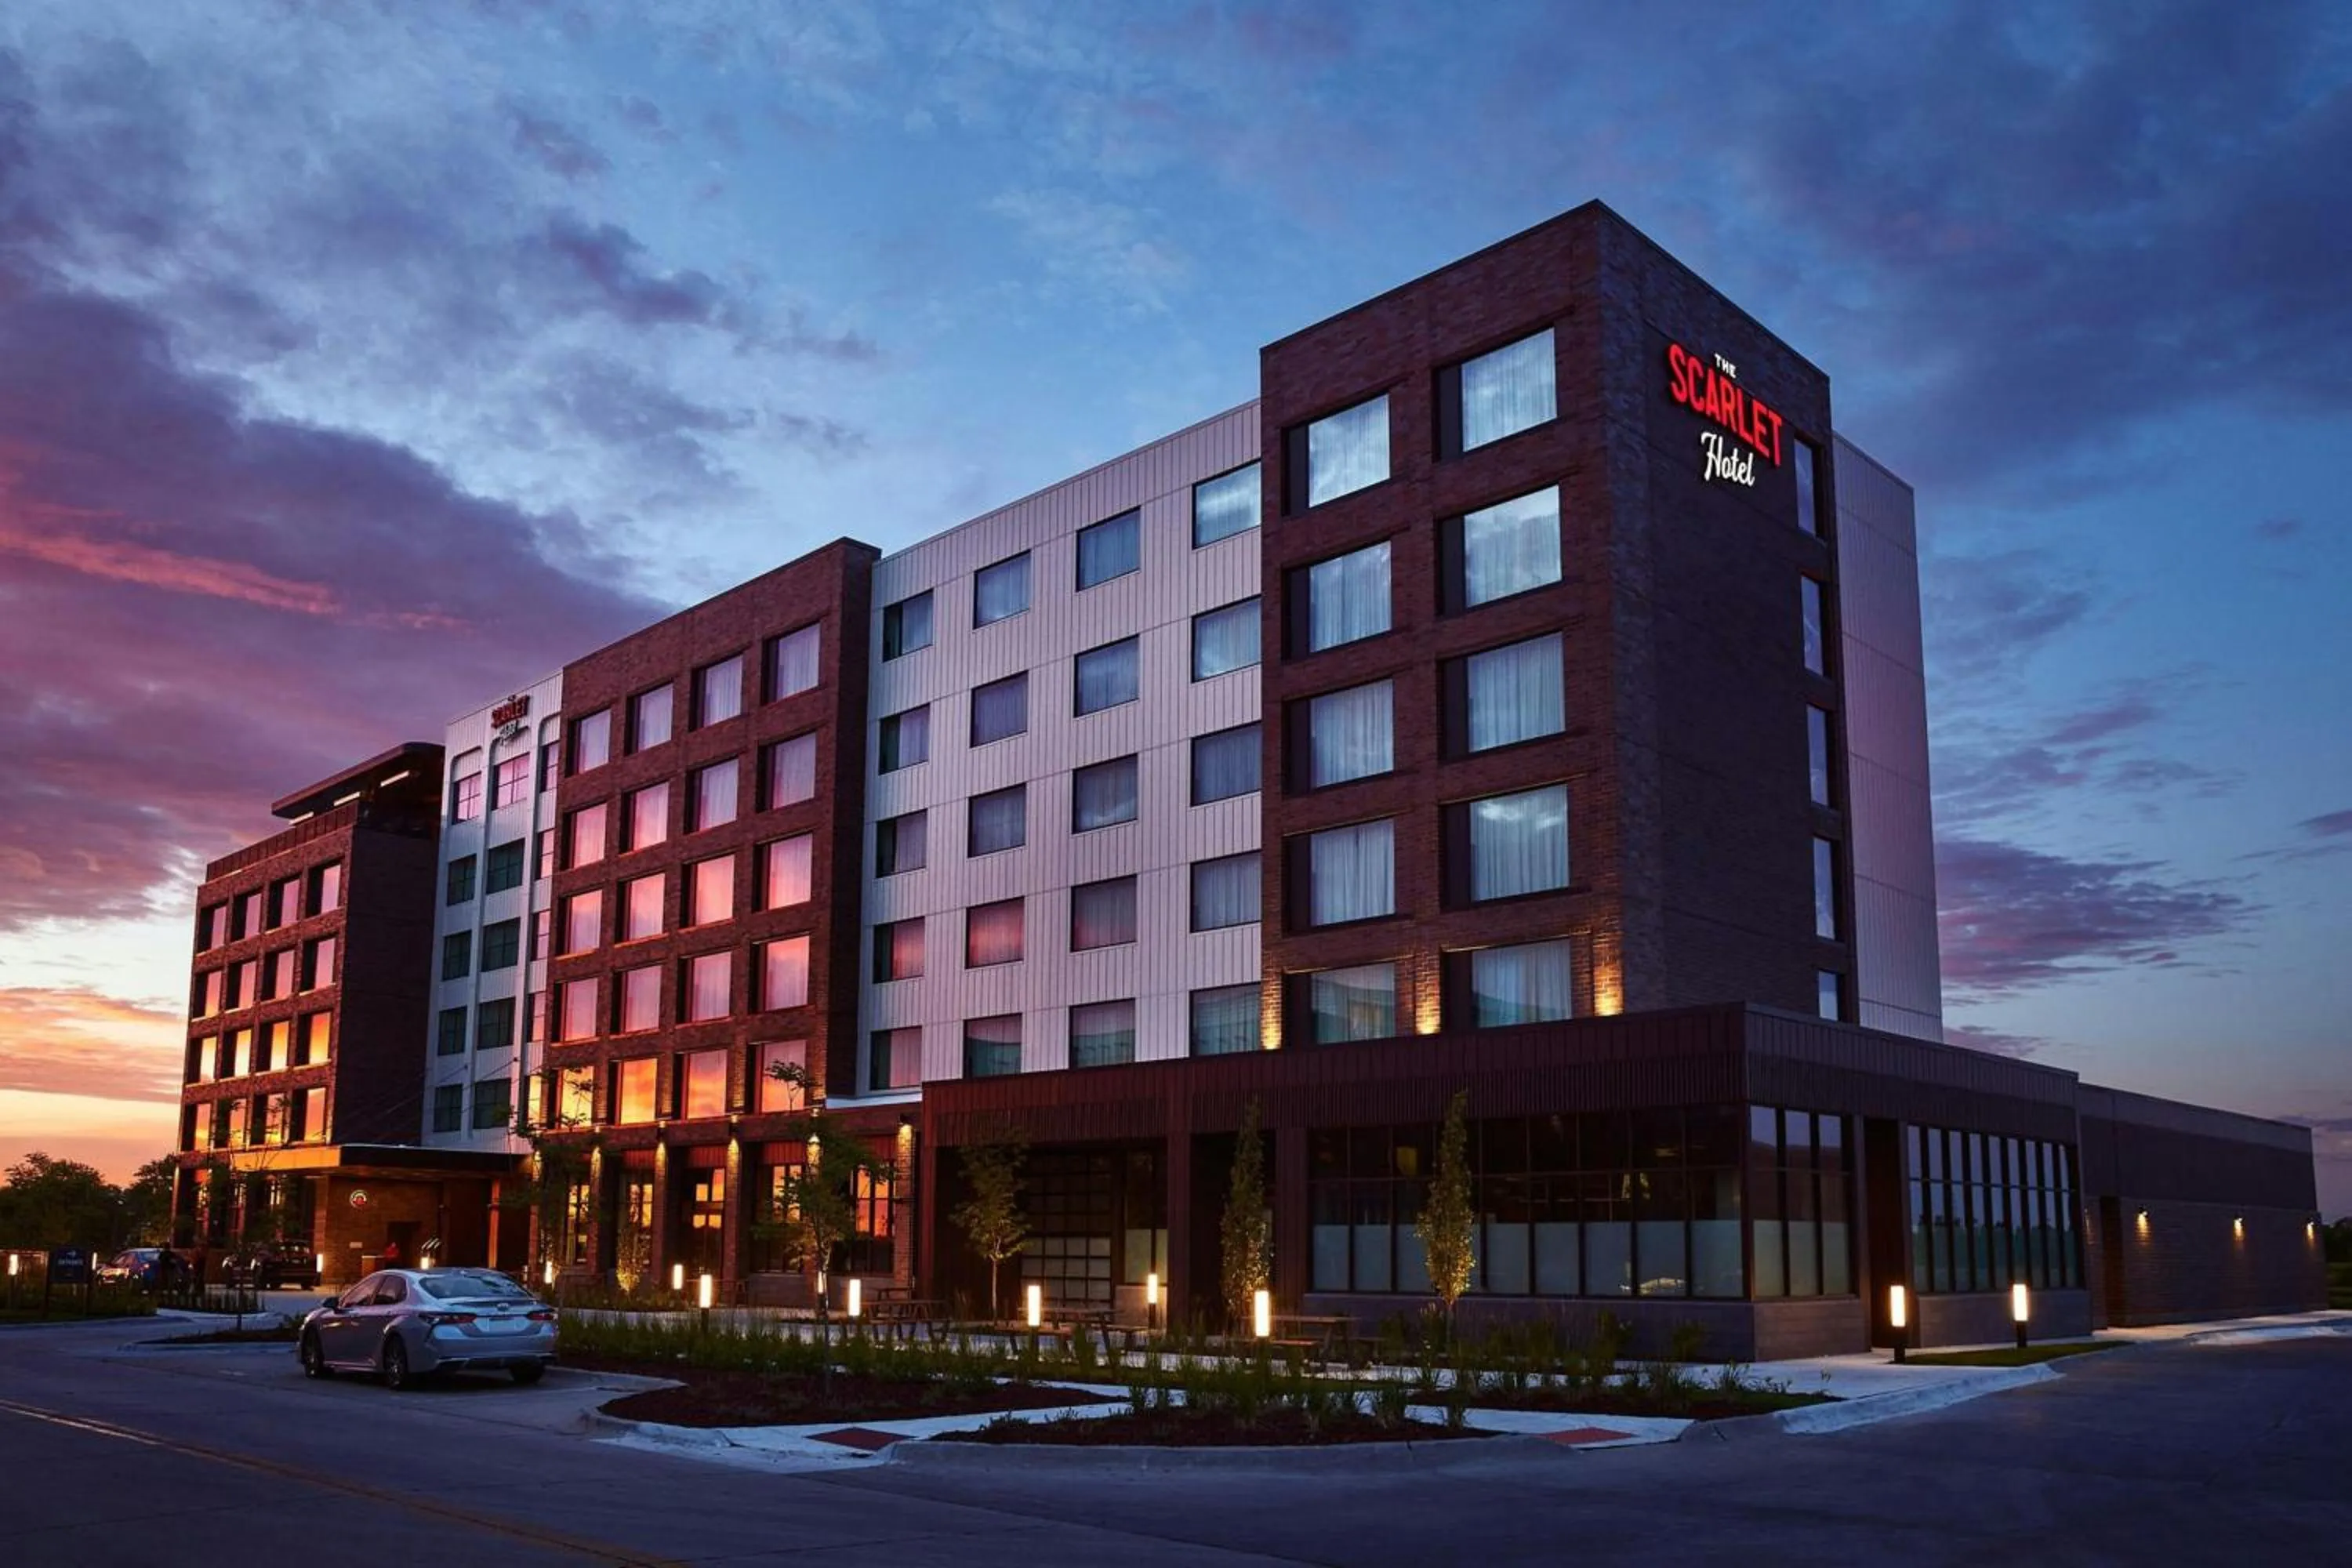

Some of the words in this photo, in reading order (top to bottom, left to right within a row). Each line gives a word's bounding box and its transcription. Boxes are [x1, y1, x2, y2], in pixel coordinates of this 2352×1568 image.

[1715, 353, 1737, 379] THE
[1668, 343, 1782, 467] SCARLET
[1700, 431, 1755, 487] Hotel
